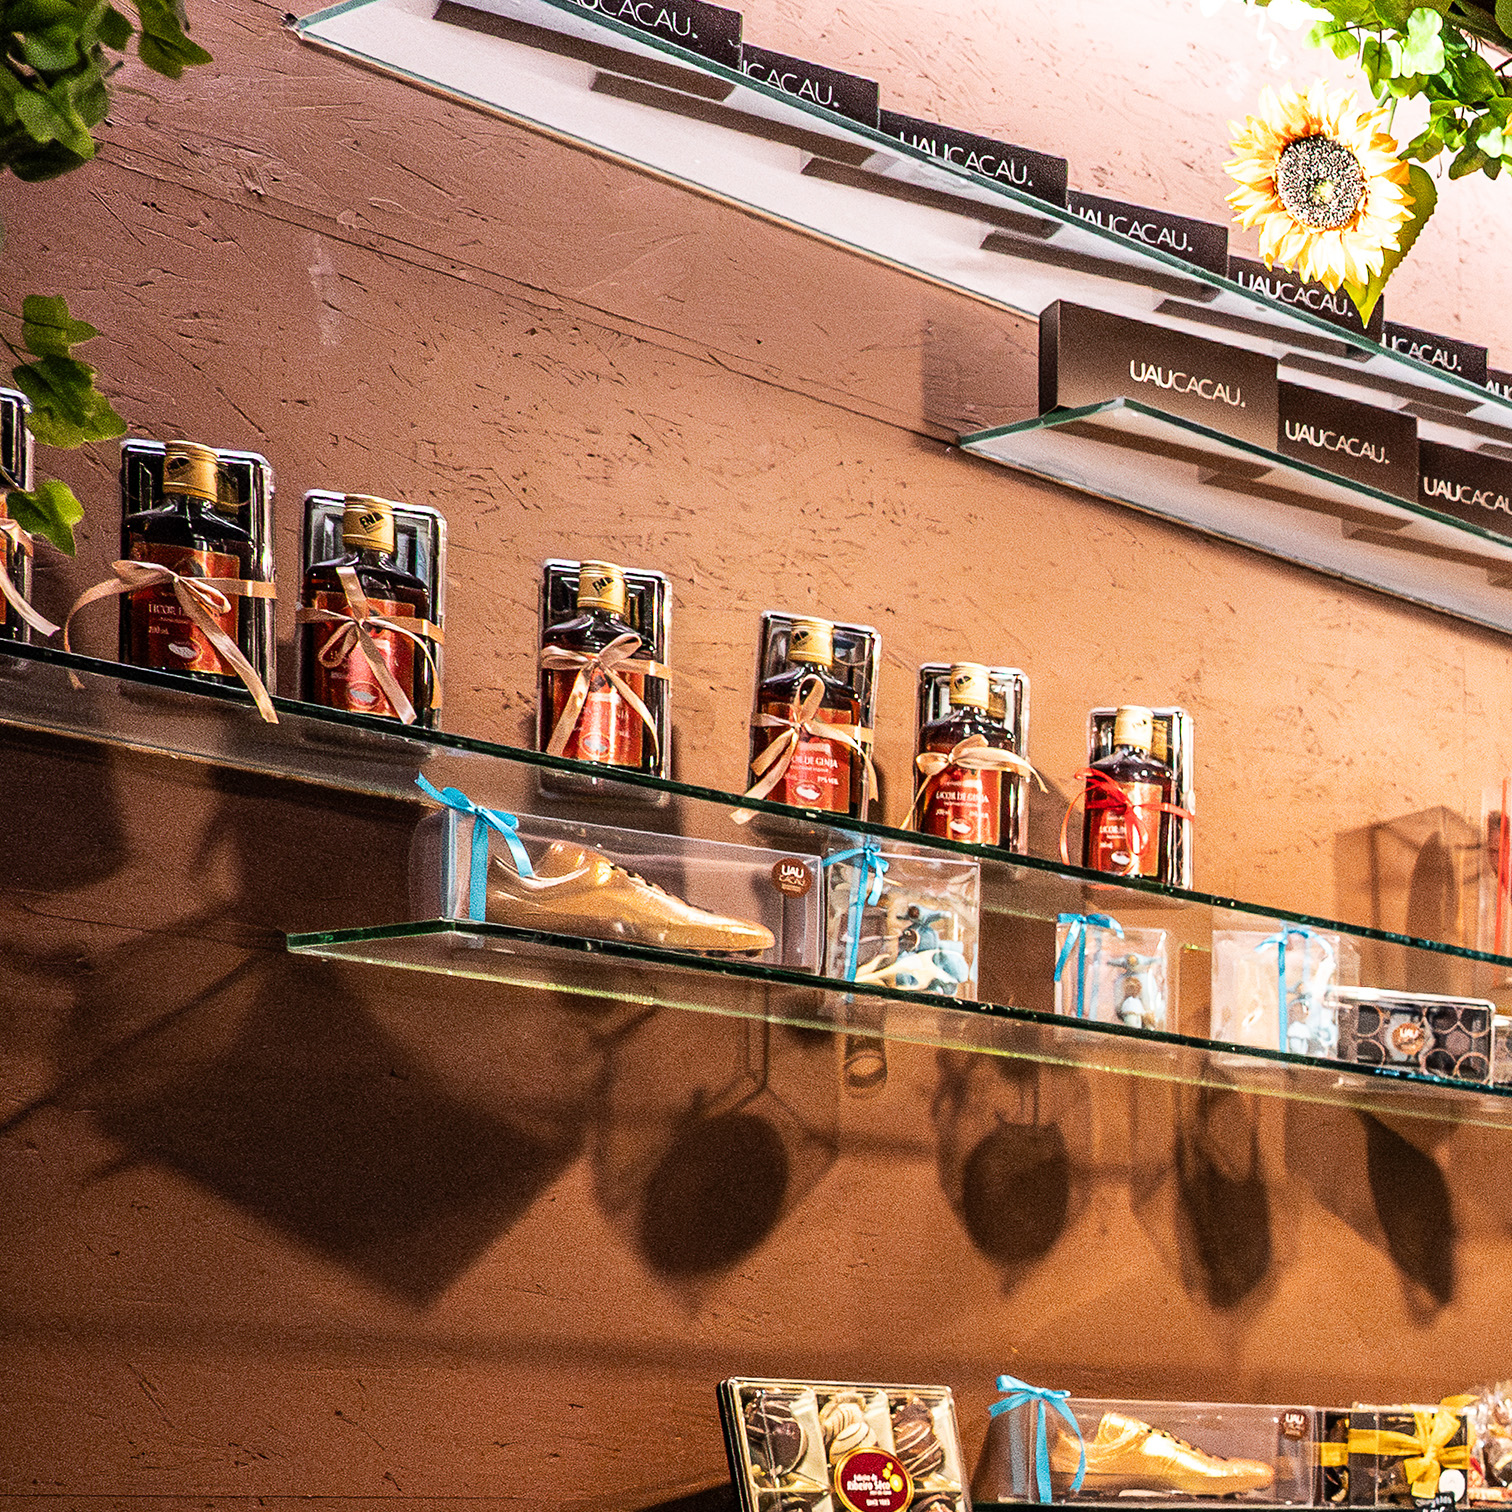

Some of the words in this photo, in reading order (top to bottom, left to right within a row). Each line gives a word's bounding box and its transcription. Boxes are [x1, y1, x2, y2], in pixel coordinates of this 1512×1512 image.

[1129, 359, 1247, 408] UAUCACAU.
[1285, 419, 1391, 465] UAUCACAU.
[781, 864, 804, 879] UAU
